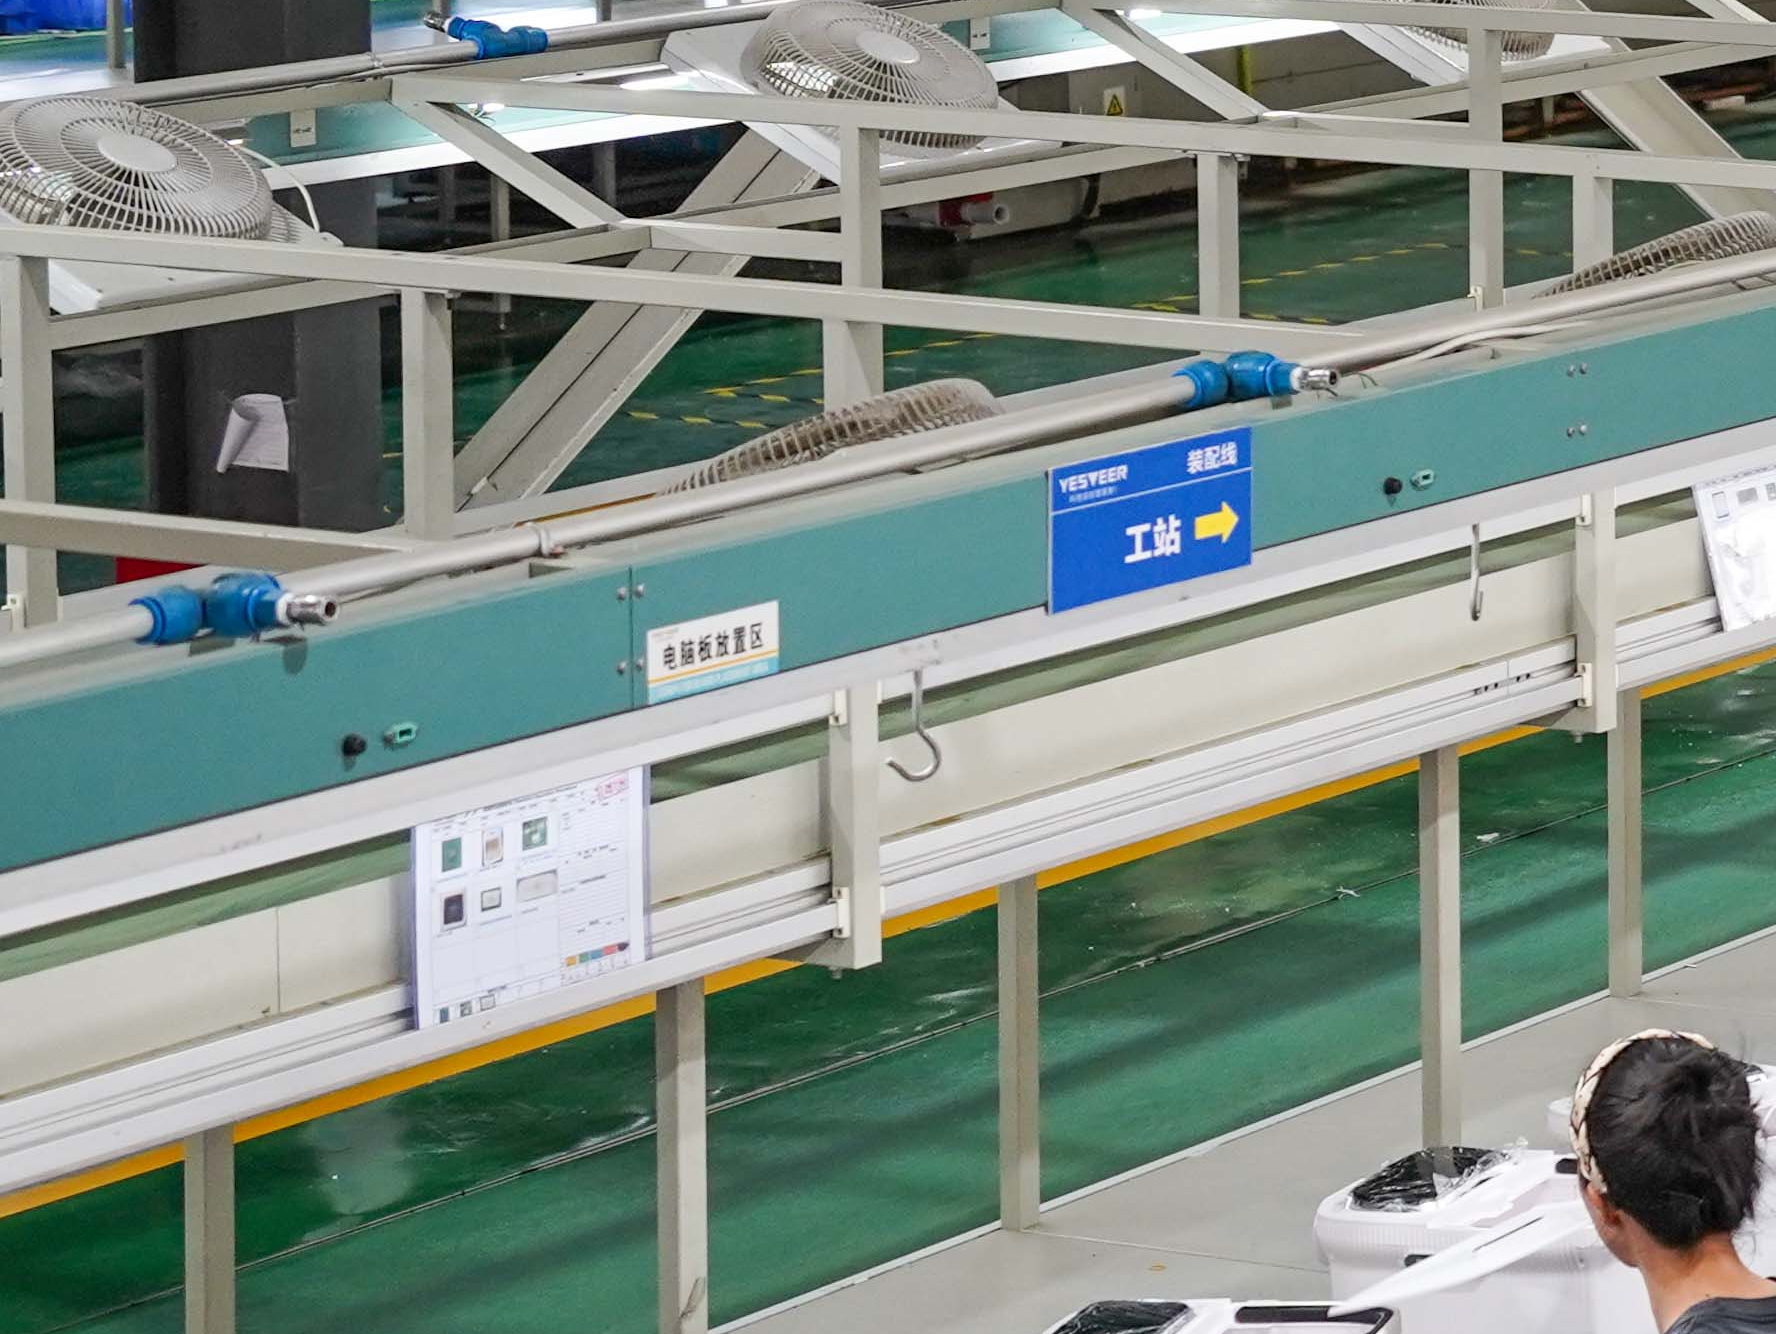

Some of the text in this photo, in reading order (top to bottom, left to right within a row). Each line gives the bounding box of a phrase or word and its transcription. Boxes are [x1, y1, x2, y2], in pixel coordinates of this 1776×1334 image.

[1186, 441, 1237, 474] 装配线
[1124, 514, 1181, 563] 工站
[663, 622, 763, 670] 电脑板放置区
